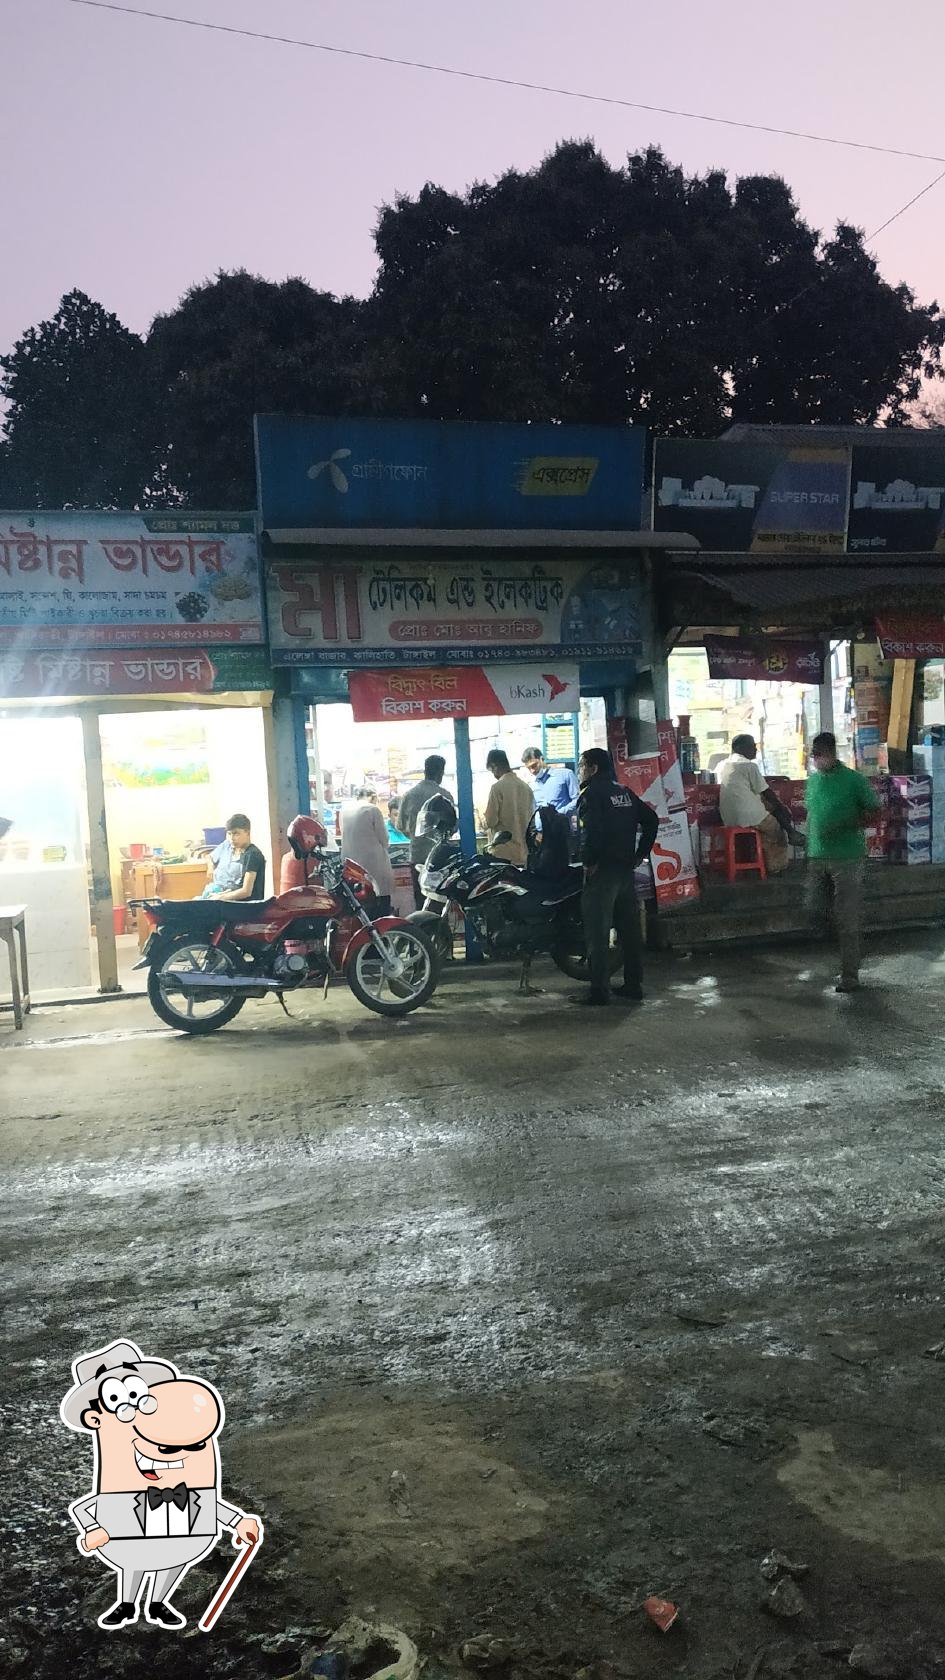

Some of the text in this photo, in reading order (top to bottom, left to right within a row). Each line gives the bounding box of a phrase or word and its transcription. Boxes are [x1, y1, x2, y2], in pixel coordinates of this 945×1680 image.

[770, 491, 840, 504] SUPER STAR
[272, 564, 363, 640] মা
[368, 563, 438, 611] টেলিকম
[120, 656, 204, 683] ভান্ডার
[387, 672, 459, 696] বিদ্যুৎ বিল
[509, 683, 546, 699] bKash
[381, 697, 467, 716] বিকাশ করুন
